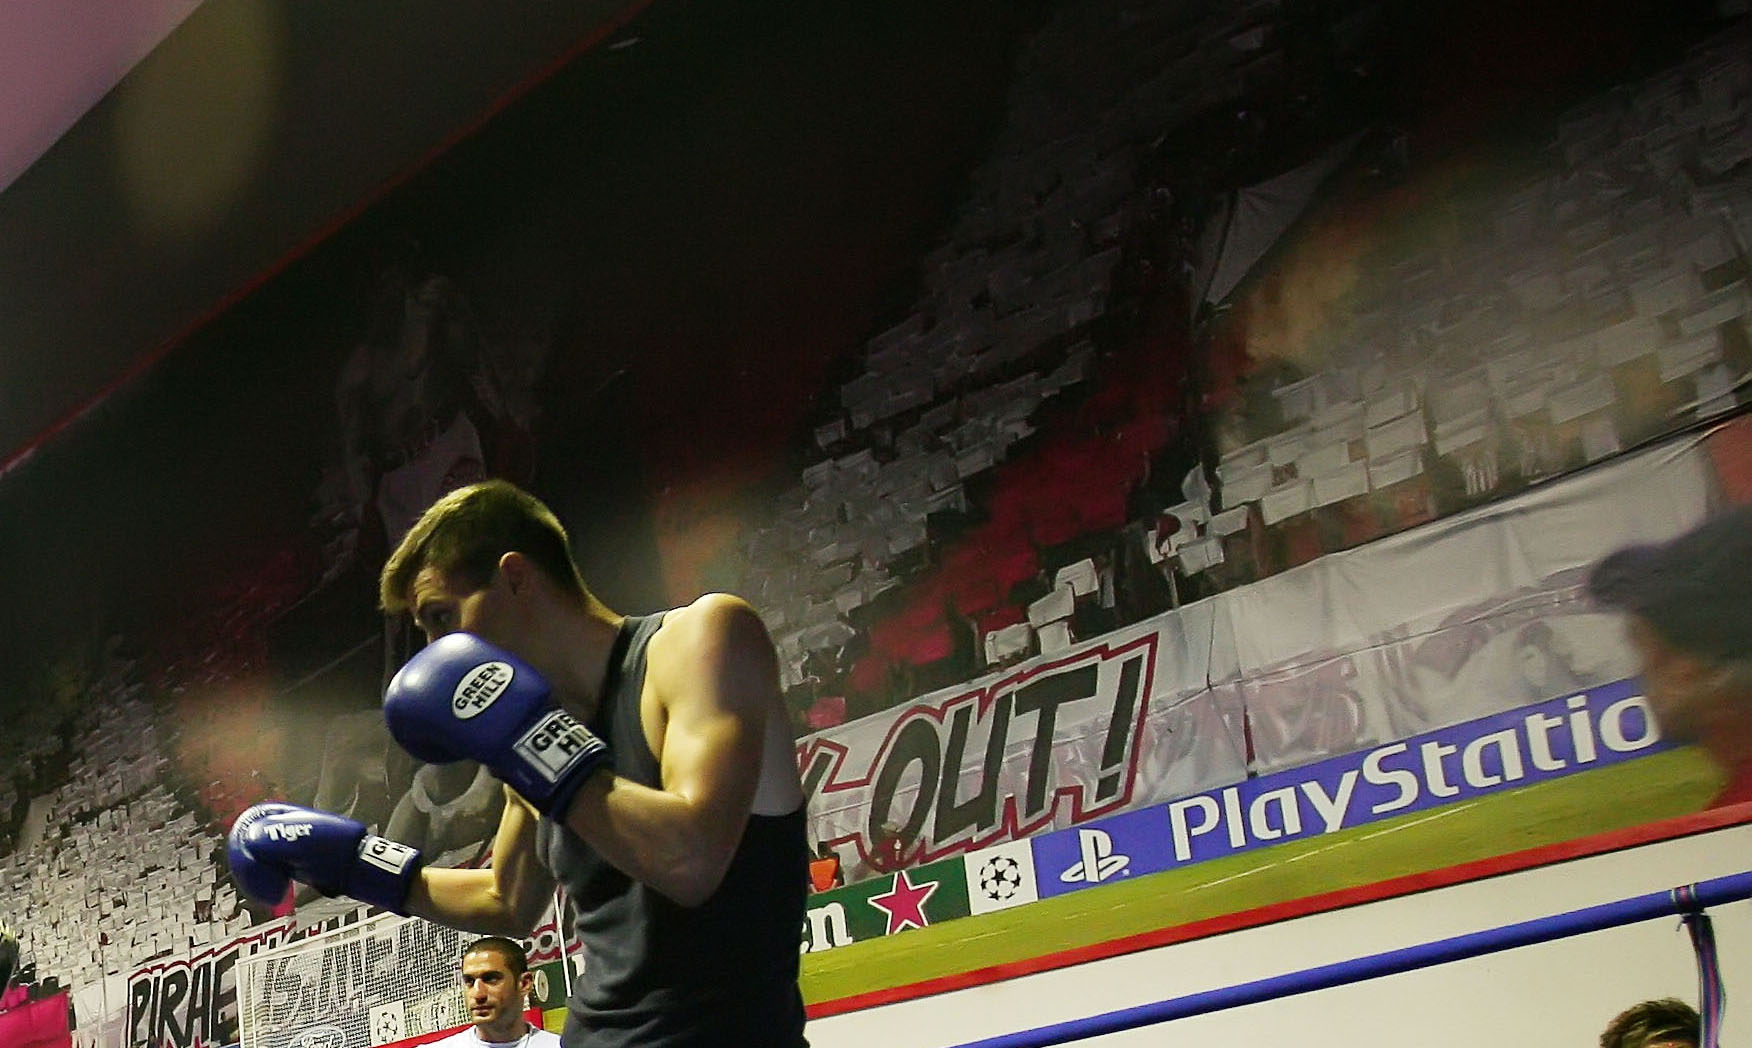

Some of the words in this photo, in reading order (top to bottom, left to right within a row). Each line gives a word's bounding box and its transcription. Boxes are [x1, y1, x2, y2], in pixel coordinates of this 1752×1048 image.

[455, 663, 502, 710] GREEN
[471, 678, 507, 709] HILL
[532, 714, 578, 752] GRE
[1167, 693, 1662, 863] PlayStatio
[264, 822, 313, 843] Tiger
